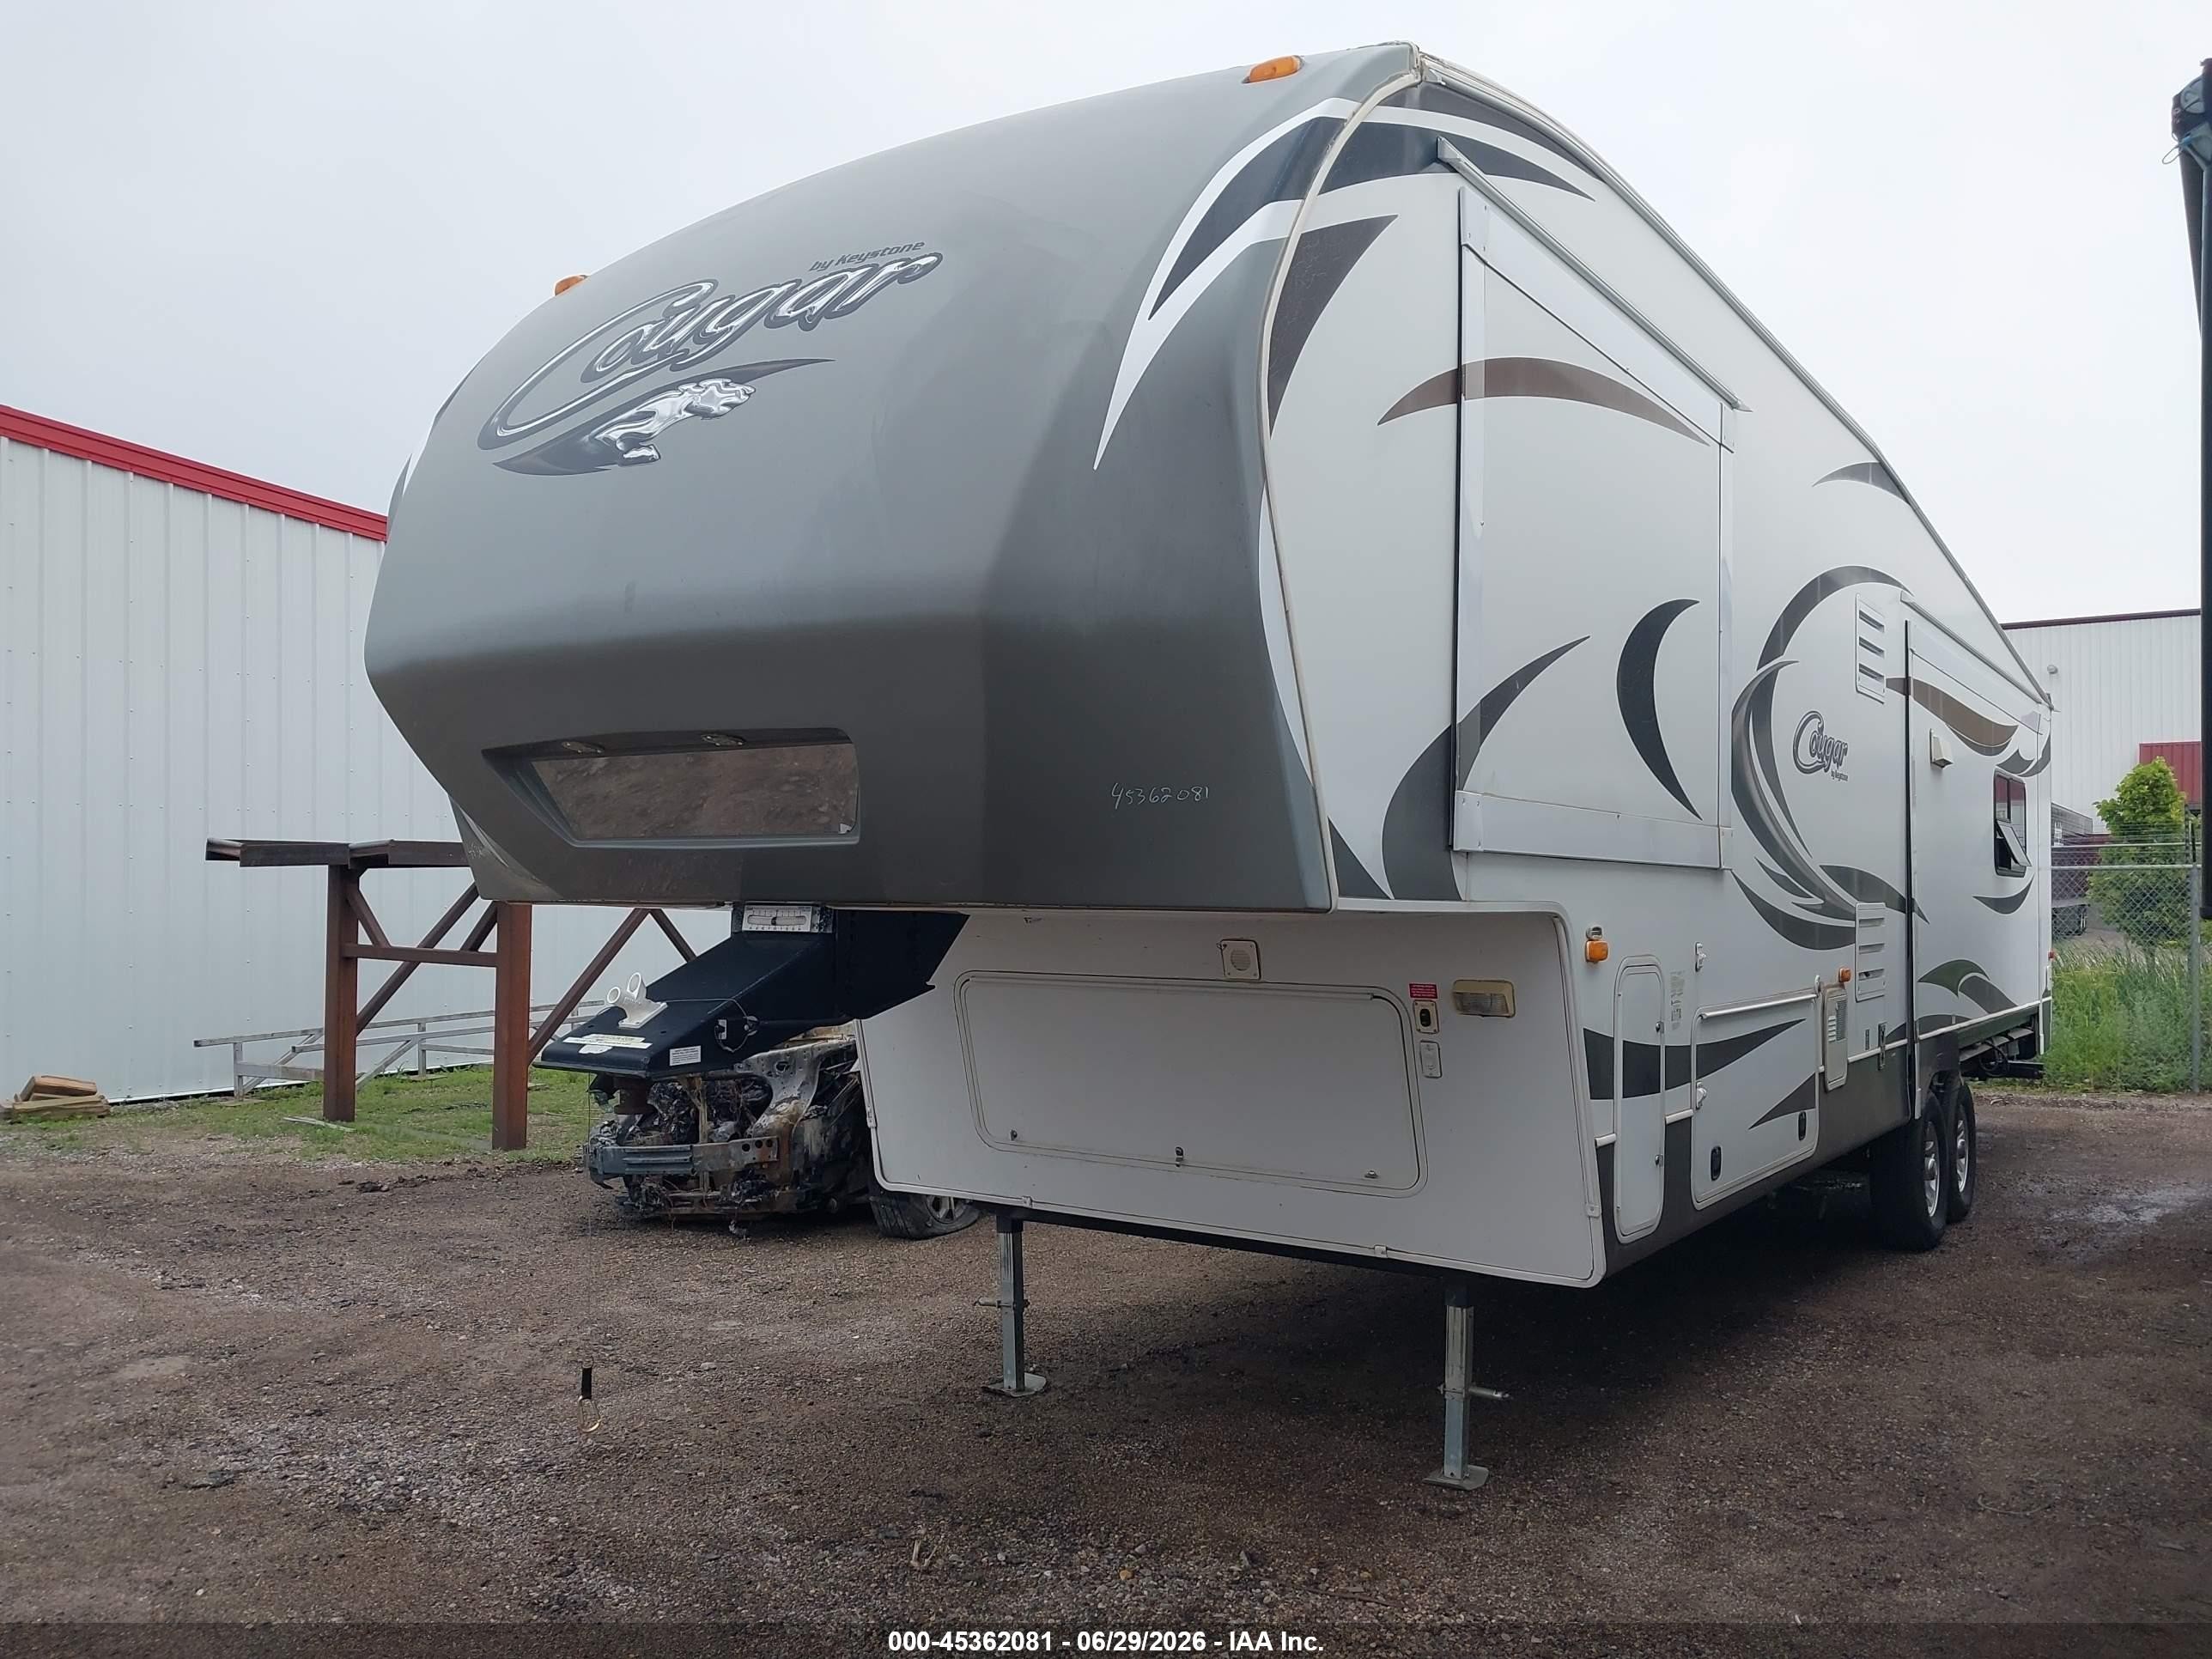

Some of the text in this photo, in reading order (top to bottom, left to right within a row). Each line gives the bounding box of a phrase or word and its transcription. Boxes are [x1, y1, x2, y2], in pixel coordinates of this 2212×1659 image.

[809, 241, 925, 272] by Keystone
[477, 252, 945, 450] Cougar
[1792, 710, 1849, 775] Cougar
[1111, 782, 1209, 810] 45362081
